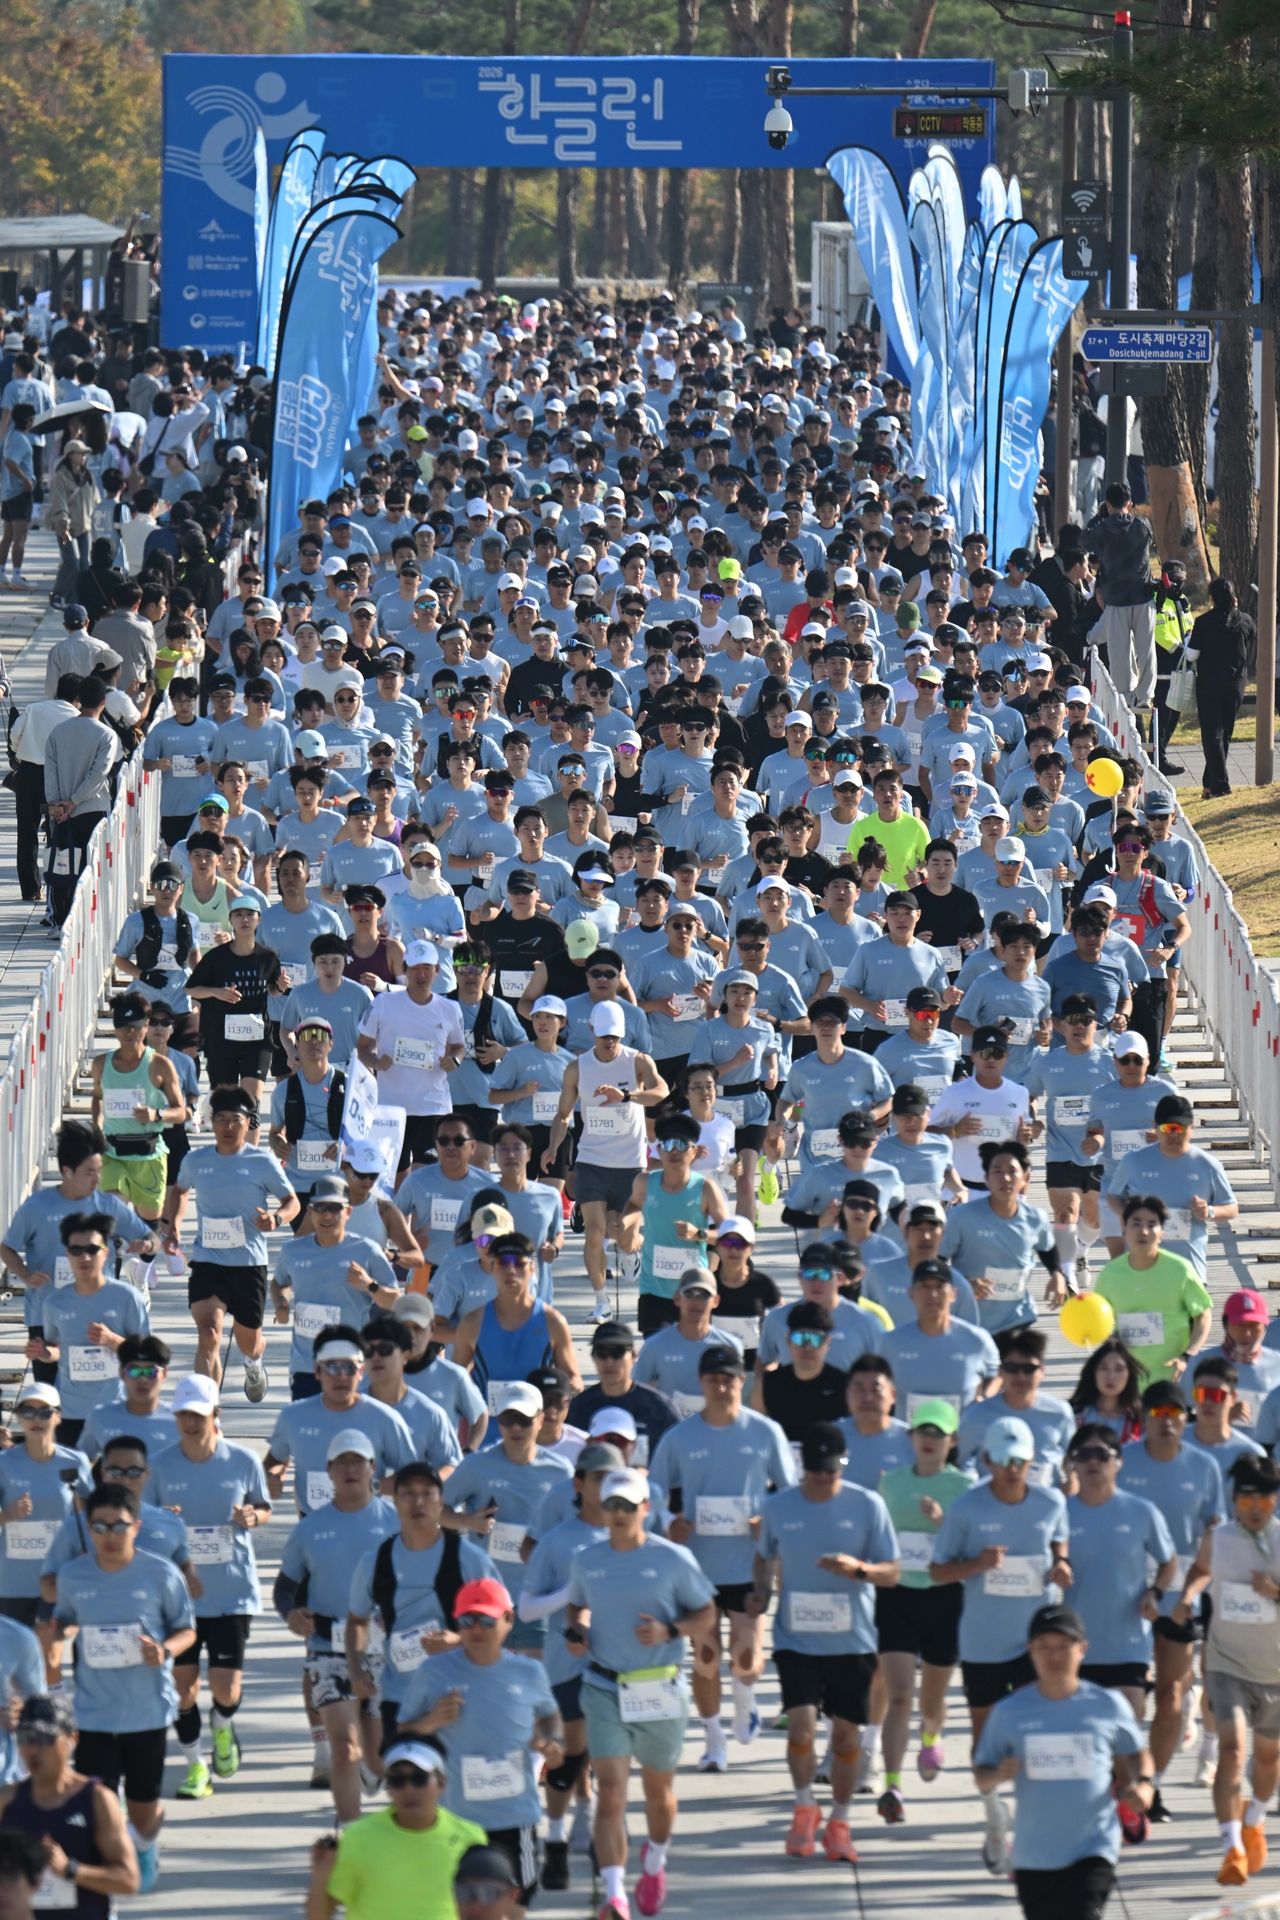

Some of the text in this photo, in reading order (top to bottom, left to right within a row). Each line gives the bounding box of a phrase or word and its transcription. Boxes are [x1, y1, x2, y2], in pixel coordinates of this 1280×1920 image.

[478, 73, 682, 161] 한글런
[920, 116, 941, 131] CCTV
[962, 116, 983, 132] 작동중
[1087, 337, 1096, 346] 37
[1117, 332, 1207, 348] 도시축제마당2길
[1109, 348, 1206, 360] Dosichukjemadang 2-gil
[397, 1049, 425, 1061] 12990
[107, 1102, 129, 1110] 11701
[536, 1105, 558, 1113] 1320
[300, 1154, 325, 1162] 12301
[204, 1232, 230, 1240] 11705
[655, 1262, 684, 1271] 11807
[72, 1361, 104, 1371] 12038
[189, 1543, 218, 1554] 2529
